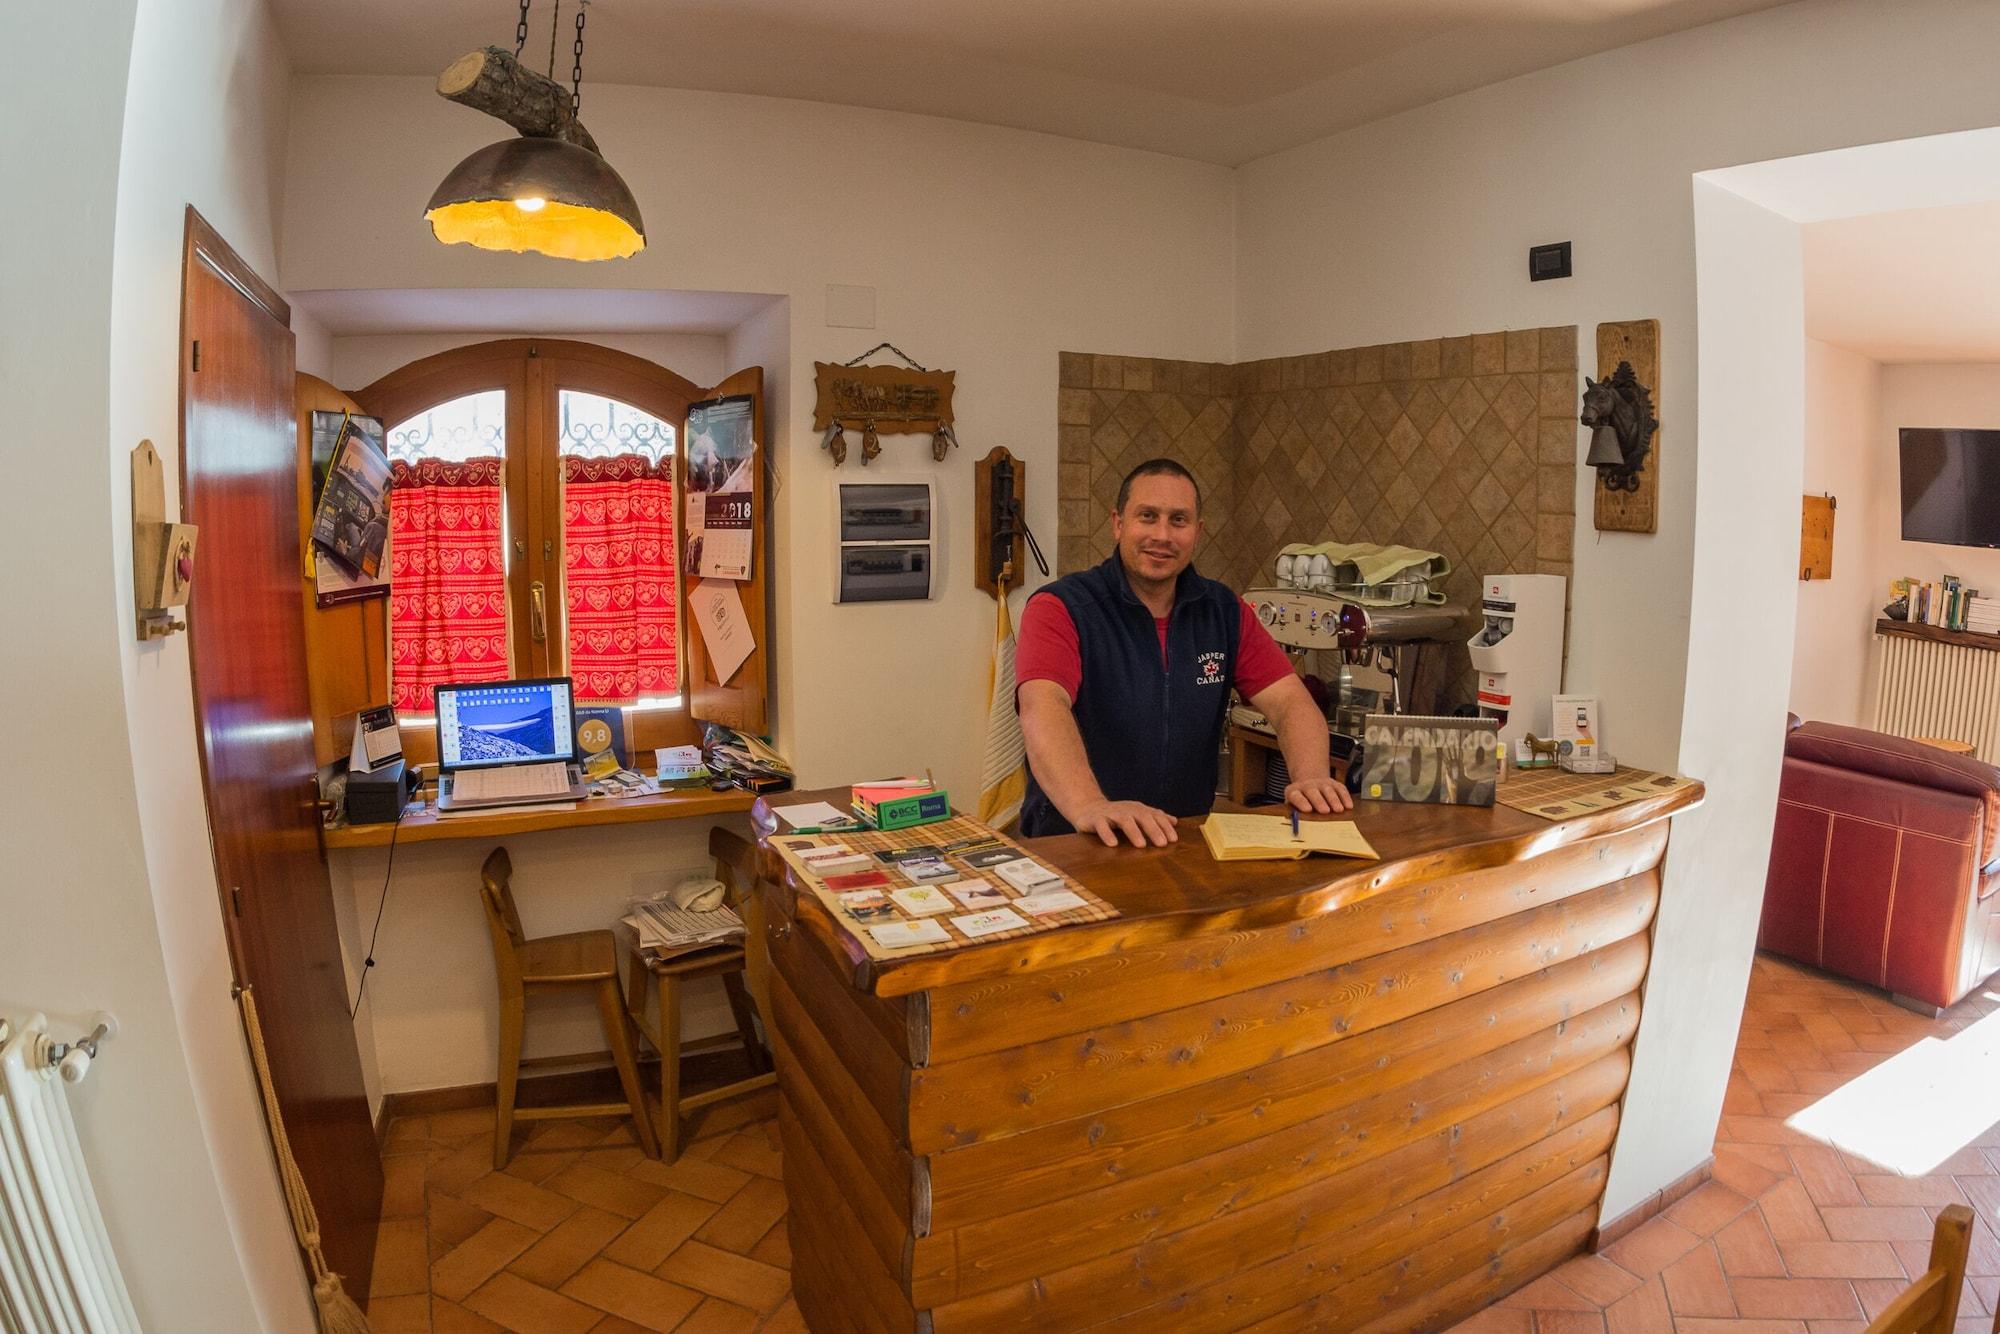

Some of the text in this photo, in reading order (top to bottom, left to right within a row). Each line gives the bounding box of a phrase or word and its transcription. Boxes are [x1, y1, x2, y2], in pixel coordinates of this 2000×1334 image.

[720, 502, 751, 518] 2018
[1197, 652, 1225, 663] JASPER
[1196, 675, 1225, 685] CANAD
[583, 729, 606, 744] 9,8
[1364, 725, 1497, 751] CALENDARIO
[898, 805, 918, 816] BCC
